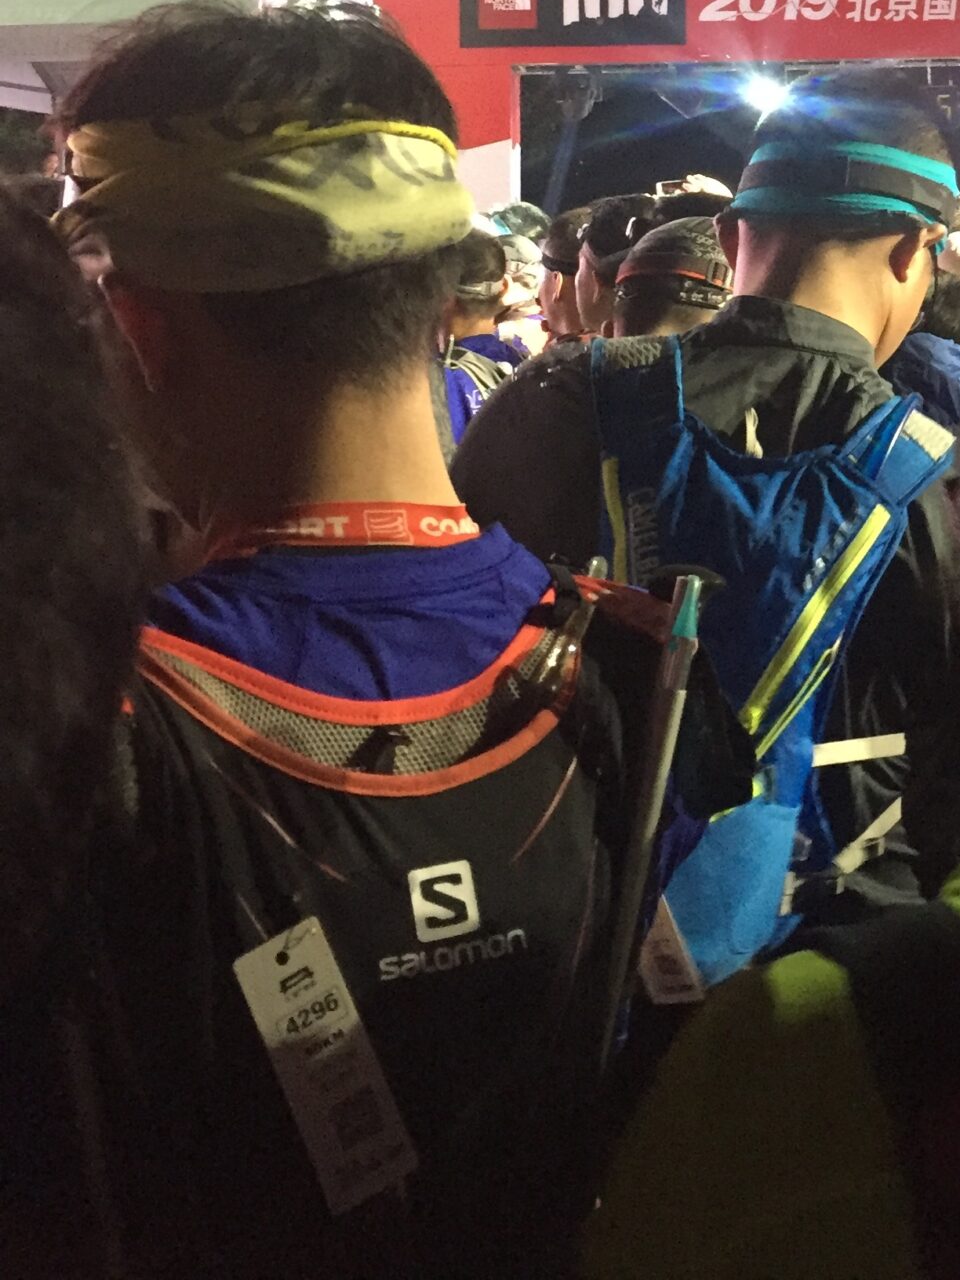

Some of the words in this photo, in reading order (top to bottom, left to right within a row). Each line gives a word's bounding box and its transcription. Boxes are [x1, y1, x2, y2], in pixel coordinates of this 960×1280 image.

[493, 3, 515, 11] FACE
[379, 928, 529, 981] salomon
[286, 992, 339, 1034] 4296
